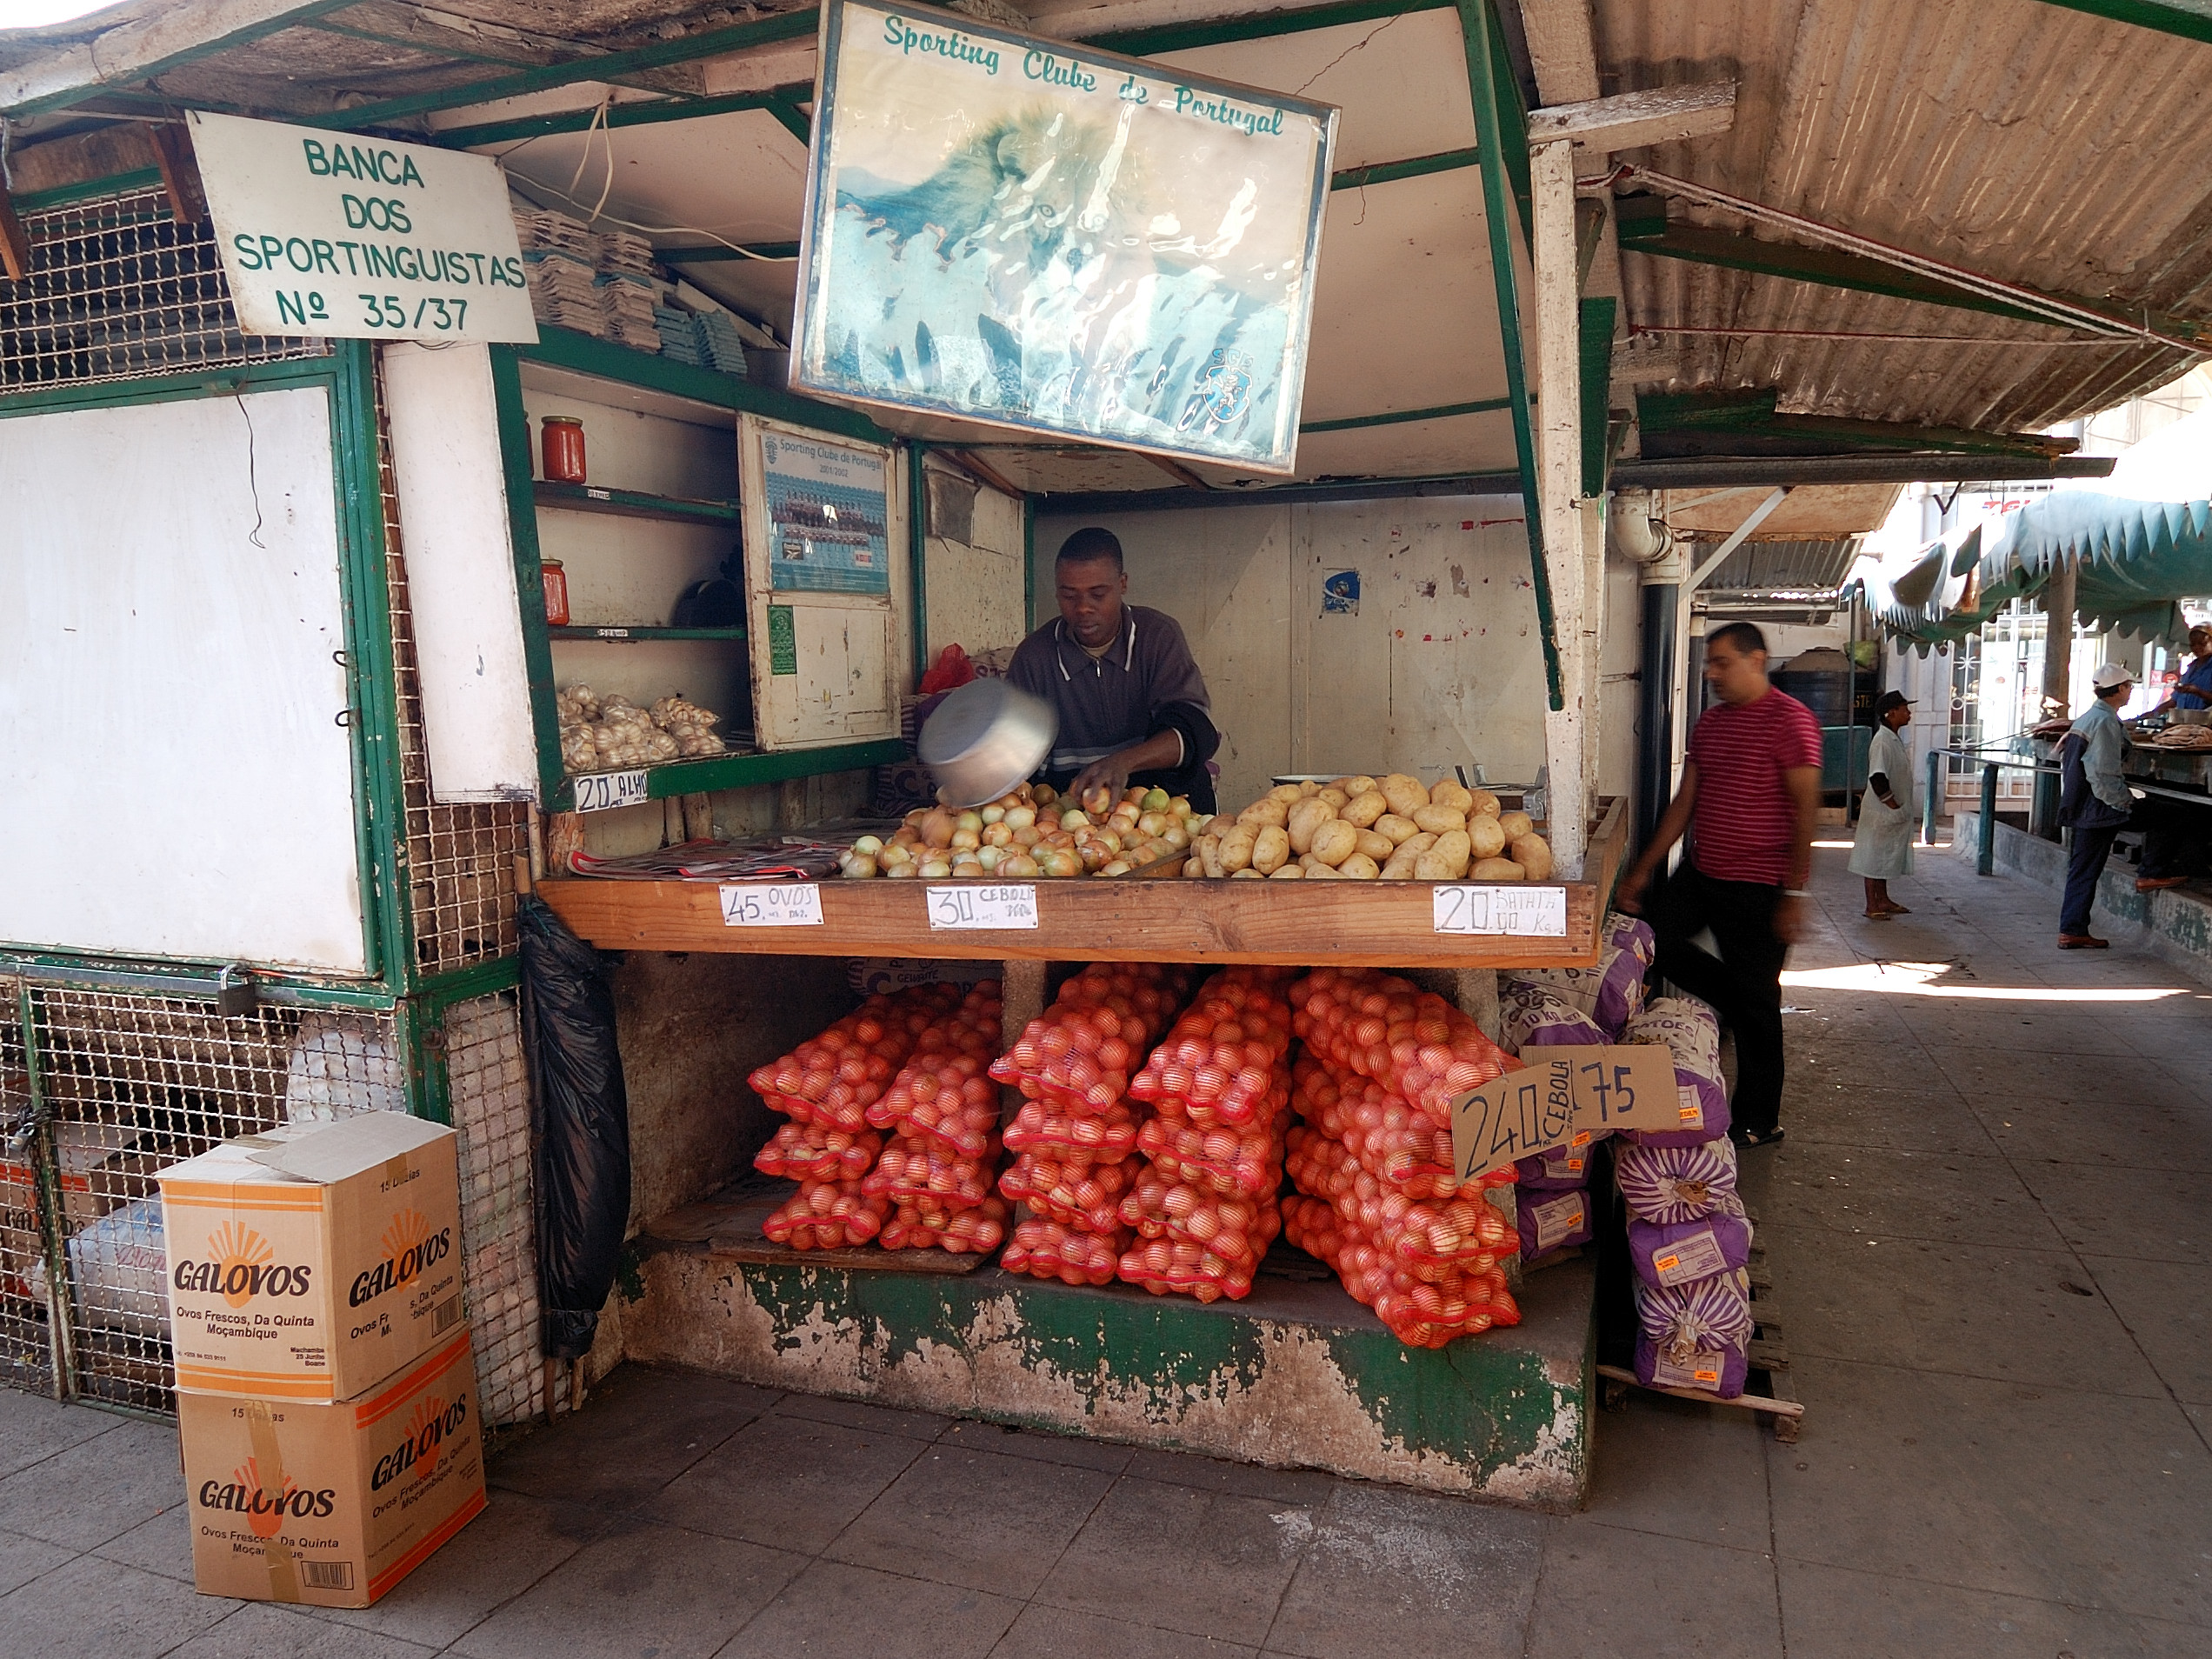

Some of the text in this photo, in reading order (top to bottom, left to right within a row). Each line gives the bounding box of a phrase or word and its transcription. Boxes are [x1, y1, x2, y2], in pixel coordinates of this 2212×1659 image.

[883, 14, 1284, 137] Sporting Clube de Portugal
[303, 138, 424, 188] BANCA
[341, 193, 412, 233] DOS
[234, 234, 526, 289] SPORTINGUISTAS
[275, 290, 469, 330] Nº 35/37
[780, 438, 883, 471] Sporting Clube de Portugal
[769, 886, 813, 906] OVOS
[1522, 1013, 1541, 1029] 10
[1542, 1060, 1569, 1139] CEBOLA
[1581, 1061, 1636, 1123] 75
[174, 1259, 311, 1297] GALOVOS
[349, 1227, 450, 1308] GALOVOS
[177, 1306, 315, 1327] Ovos Frescos, Da Quinta
[350, 1318, 376, 1339] Ovos
[419, 1291, 430, 1304] Da
[430, 1275, 453, 1296] Quinta
[206, 1323, 278, 1341] Moçambique
[231, 1408, 244, 1419] 15
[370, 1393, 466, 1492] GALOVOS
[372, 1496, 397, 1518] Ovos
[399, 1469, 436, 1501] Frescos,
[436, 1457, 448, 1470] Da
[450, 1436, 470, 1460] Quinta
[400, 1464, 453, 1511] Moçambique
[199, 1480, 336, 1518] GALOVOS
[201, 1525, 227, 1539] Ovos
[280, 1536, 295, 1547] Da
[299, 1537, 339, 1549] Quinta
